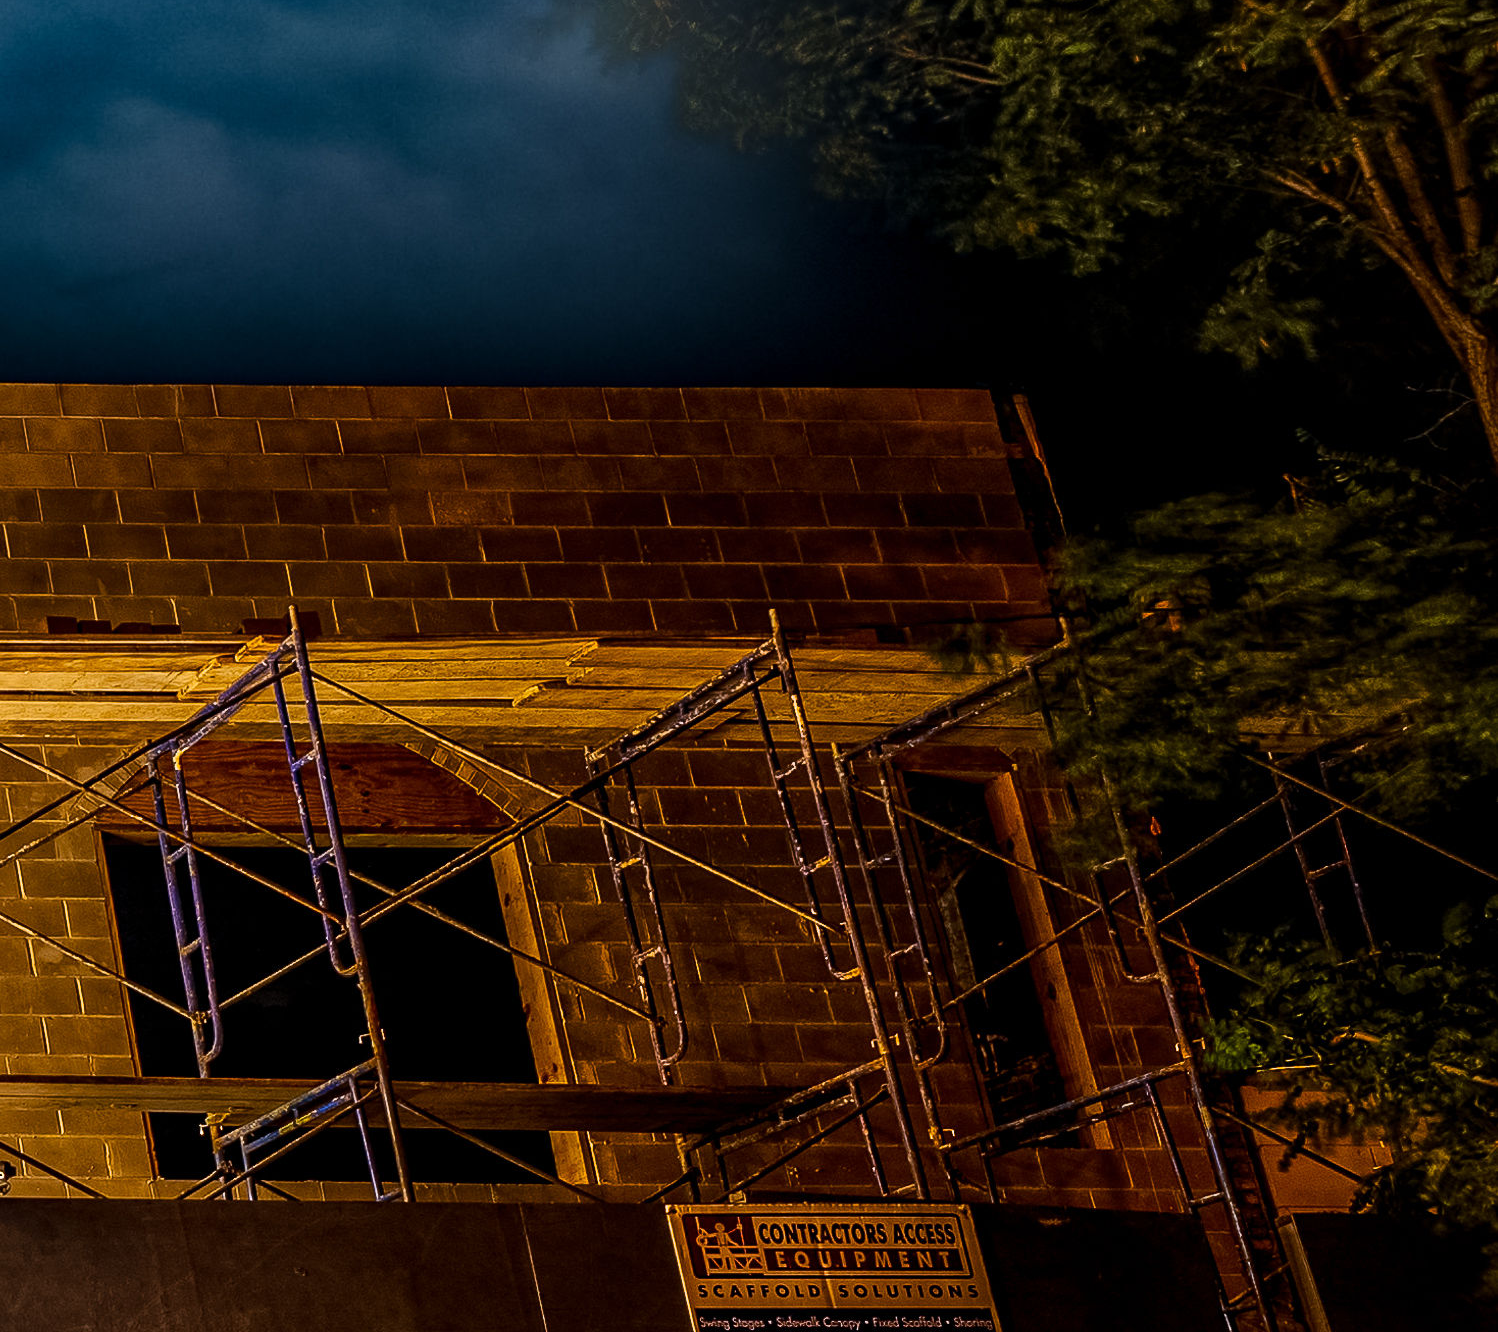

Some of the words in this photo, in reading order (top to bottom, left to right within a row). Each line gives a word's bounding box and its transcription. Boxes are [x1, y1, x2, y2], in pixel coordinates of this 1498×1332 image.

[758, 1222, 889, 1245] CONTRACTORS
[893, 1224, 956, 1245] ACCESS
[775, 1250, 952, 1269] EQUIPMENT
[698, 1284, 821, 1298] SCAFFOLD
[838, 1284, 980, 1298] SOLUTIONS
[699, 1316, 730, 1331] Swing
[732, 1317, 766, 1331] Stages
[776, 1316, 821, 1328] Sidewalk
[822, 1317, 861, 1331] Canopy
[872, 1317, 899, 1328] Fixed
[901, 1317, 943, 1329] Scaffold
[953, 1317, 993, 1331] Shoring
